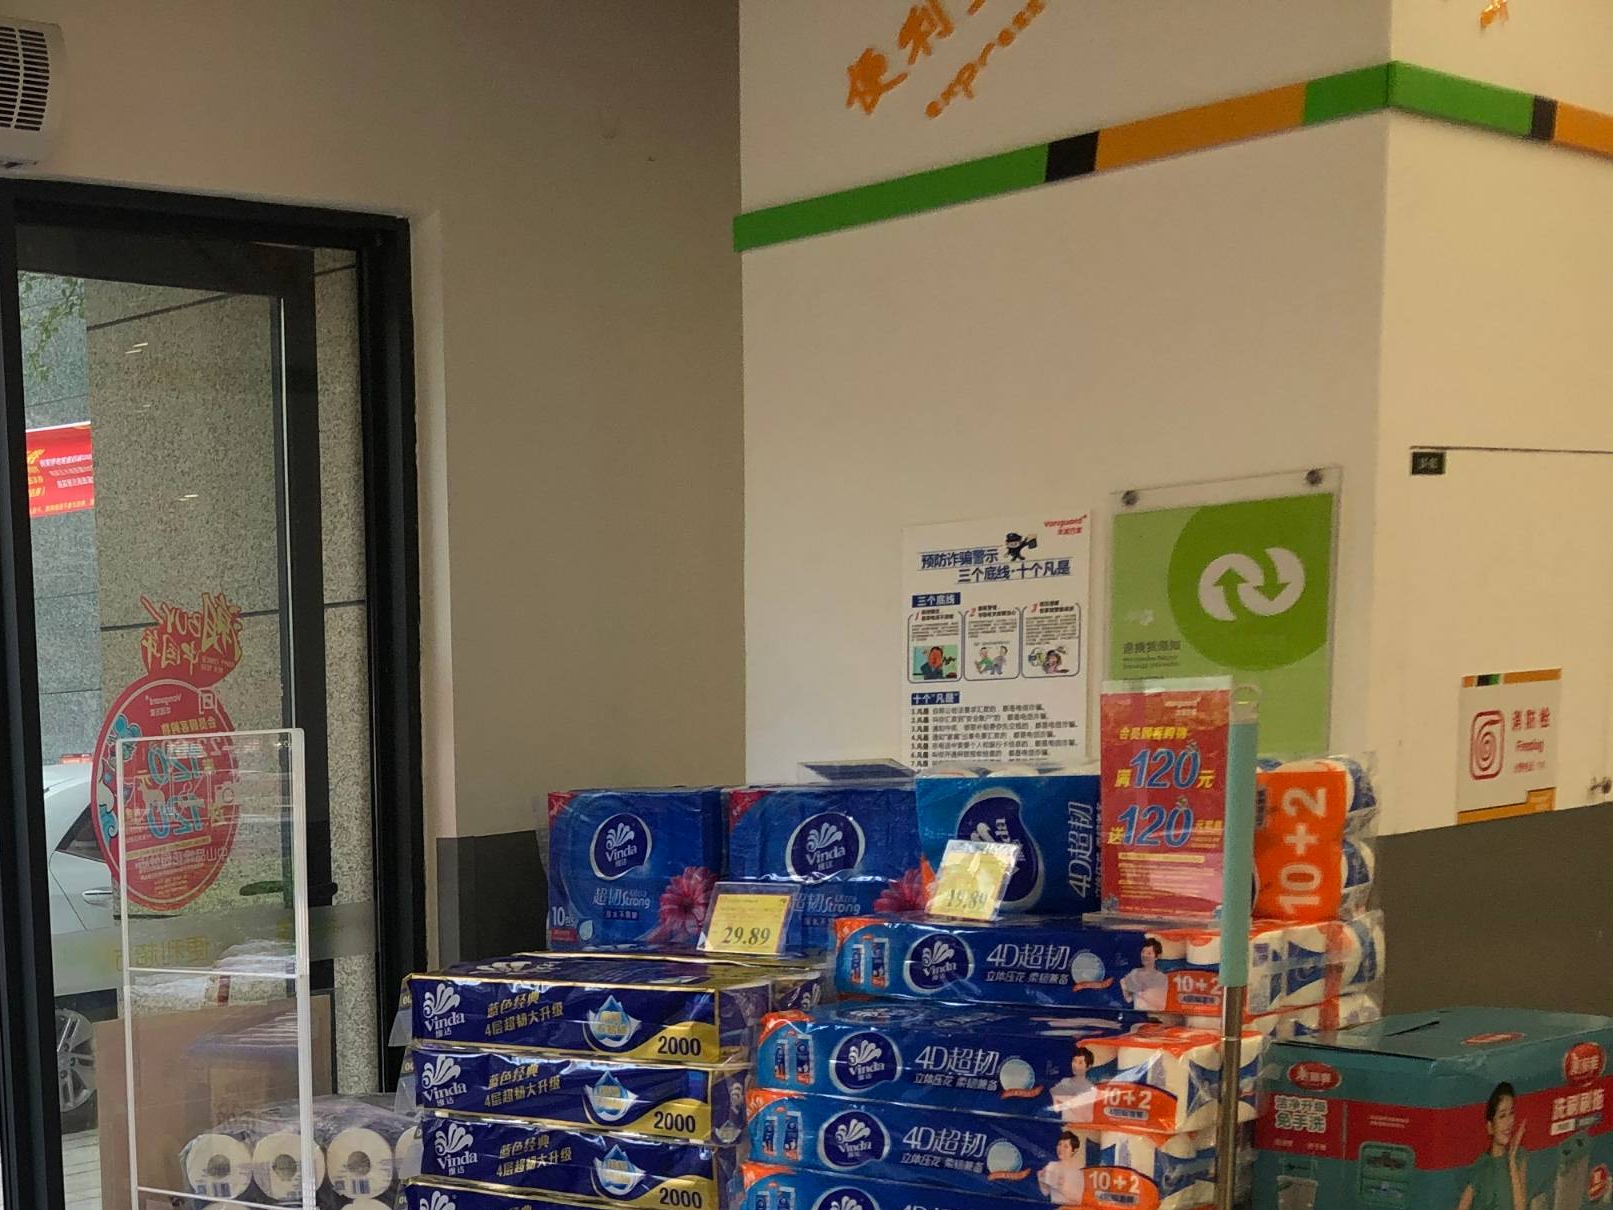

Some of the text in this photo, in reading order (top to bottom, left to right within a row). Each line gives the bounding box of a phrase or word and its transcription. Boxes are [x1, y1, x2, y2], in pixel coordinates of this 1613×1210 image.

[921, 549, 998, 570] 预防诈骗警示
[916, 594, 956, 606] 三个底线
[605, 845, 637, 863] Vinda
[805, 845, 846, 866] Vinda
[1068, 801, 1093, 898] 4D超韧
[1278, 786, 1329, 914] 10+2
[722, 927, 771, 946] 29.89
[985, 943, 1070, 972] 4D超韧
[922, 961, 957, 977] Vinda
[986, 970, 1025, 984] 立体压花
[1175, 975, 1222, 997] 10+2
[486, 991, 540, 1019] 蓝色经典
[424, 1011, 466, 1033] Vinda
[657, 1035, 701, 1058] 2000
[847, 1061, 885, 1078] Vinda
[914, 1045, 998, 1077] 4D超韧
[488, 1063, 540, 1090] 蓝色经典
[913, 1072, 952, 1087] 立体压花
[422, 1080, 468, 1103] Vinda
[1102, 1089, 1153, 1111] 10+2
[653, 1110, 696, 1134] 2000
[1275, 1111, 1327, 1133] 免手洗
[498, 1135, 550, 1160] 蓝色经典
[836, 1139, 873, 1155] Vinda
[902, 1125, 987, 1158] 4D超韧
[436, 1148, 479, 1170] Vinda
[901, 1152, 941, 1168] 立体压花
[1090, 1170, 1142, 1194] 10+2
[659, 1186, 702, 1209] 2000
